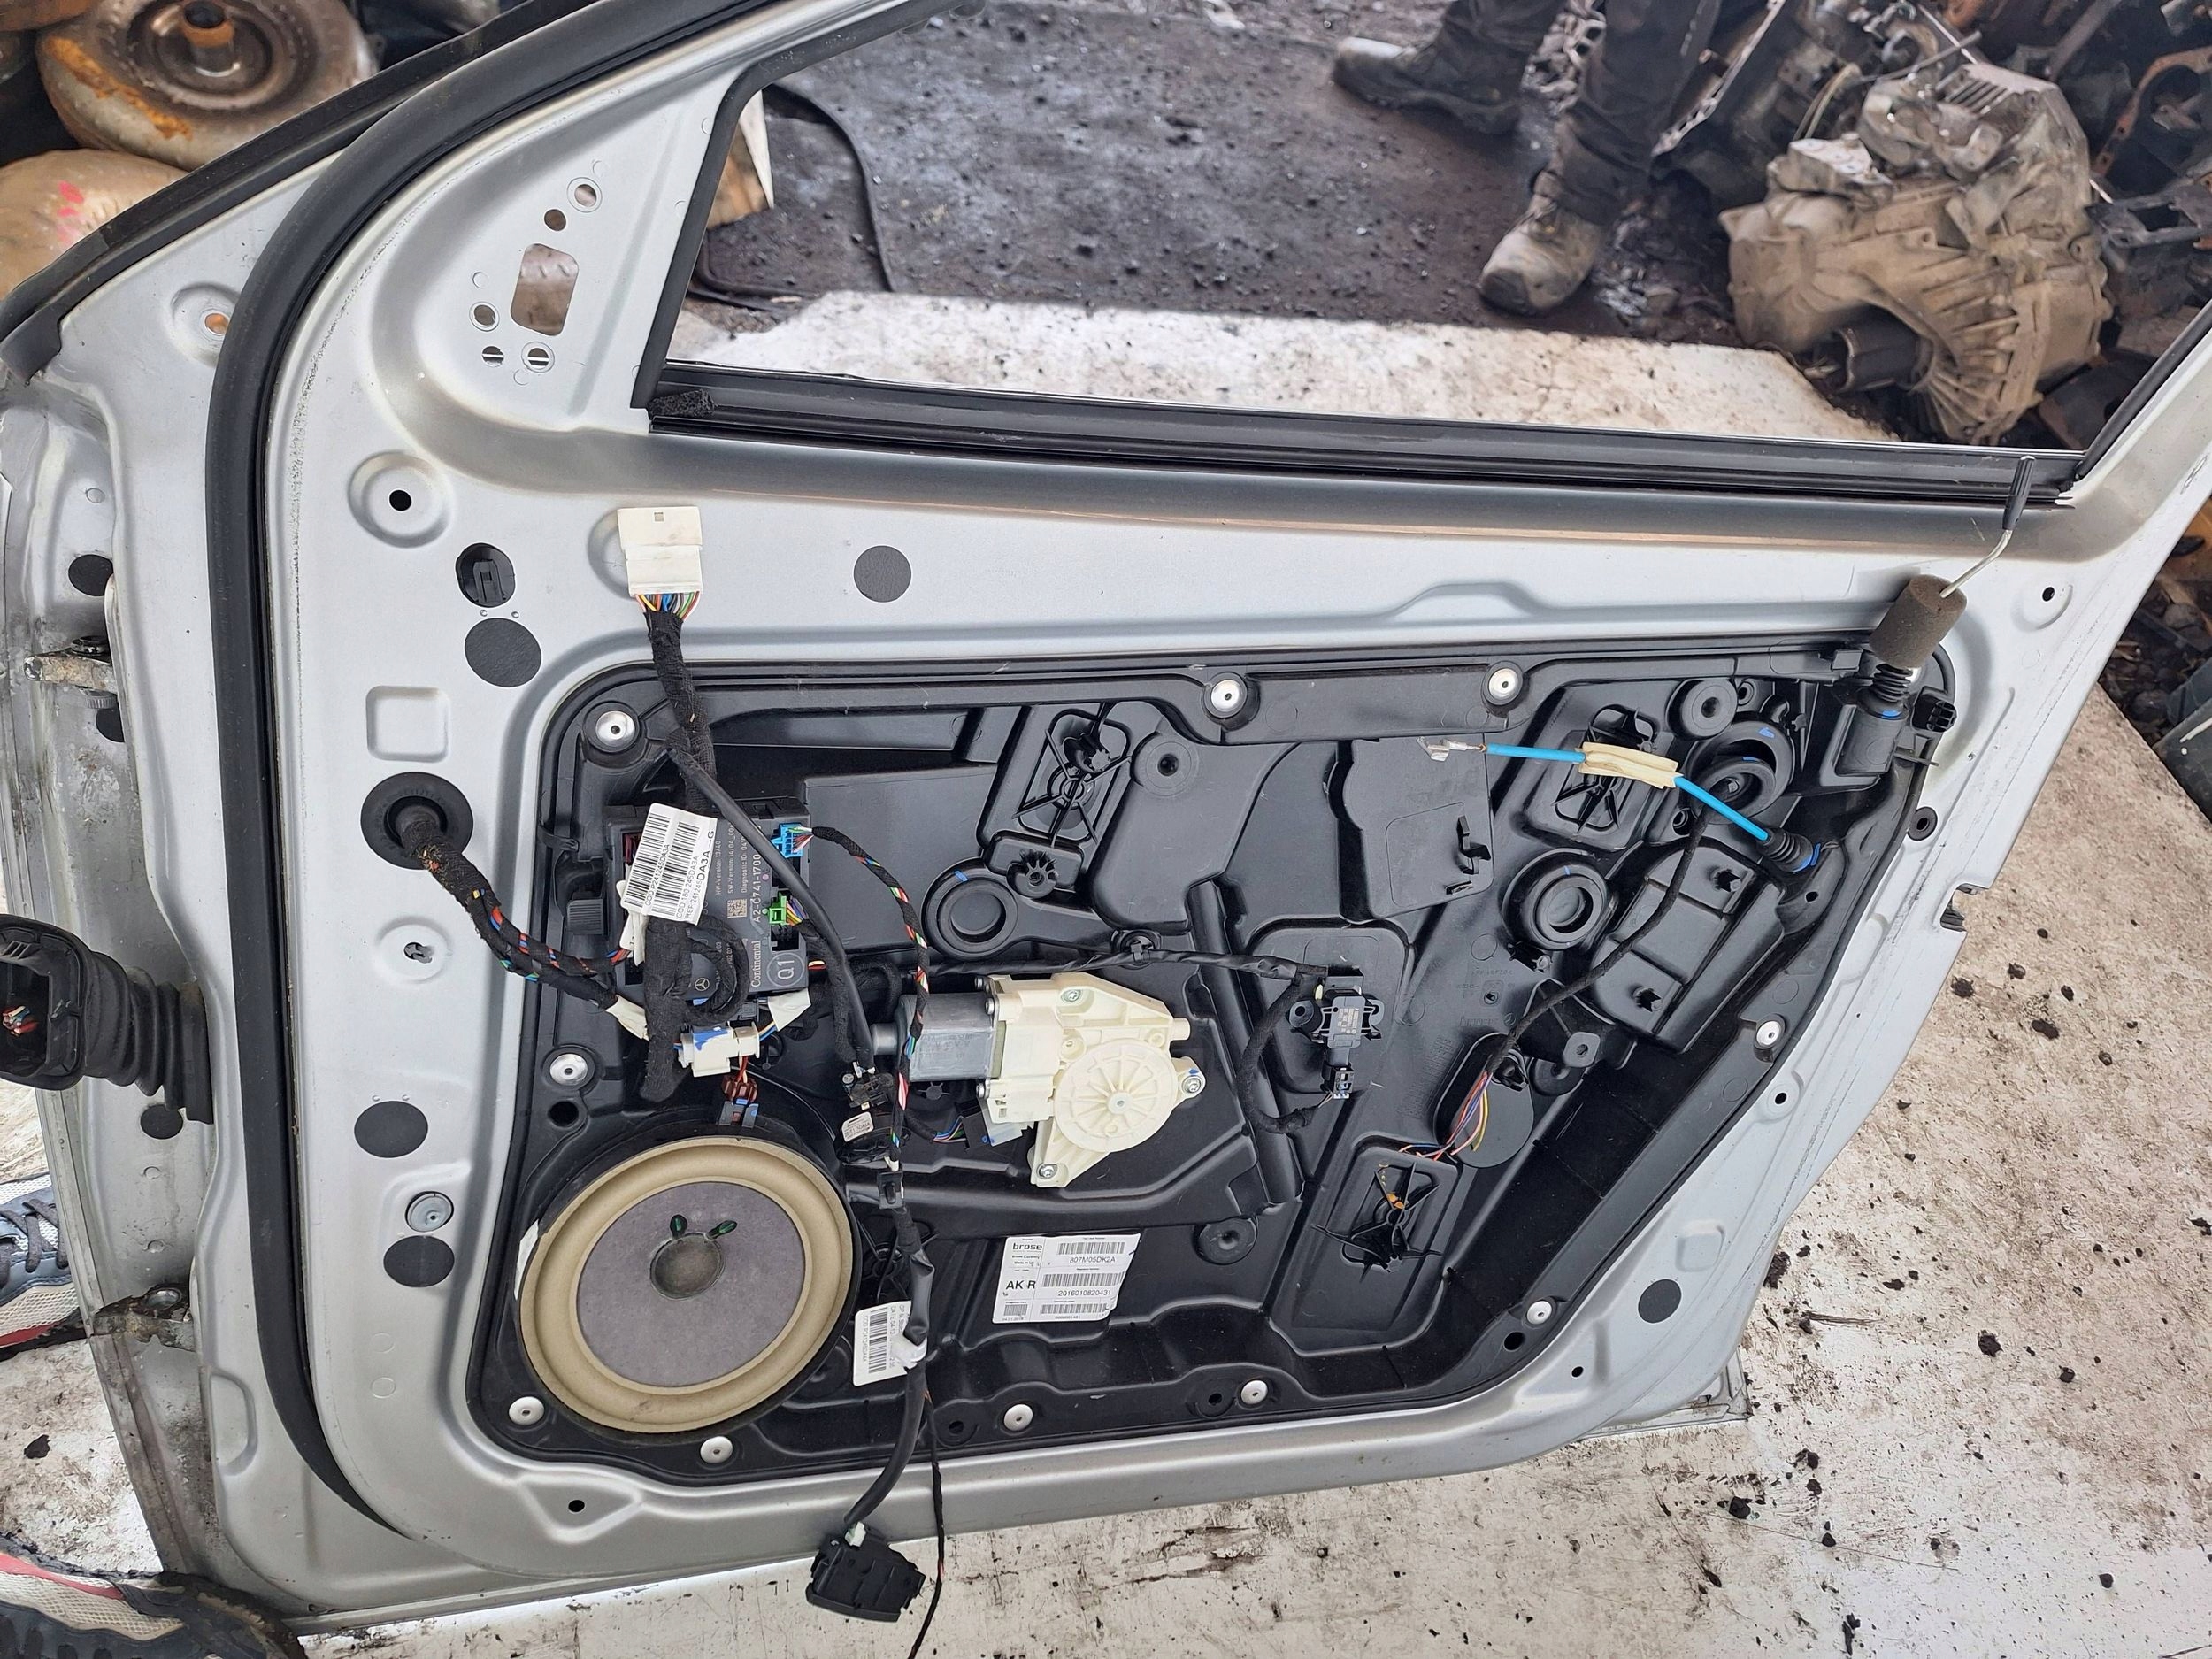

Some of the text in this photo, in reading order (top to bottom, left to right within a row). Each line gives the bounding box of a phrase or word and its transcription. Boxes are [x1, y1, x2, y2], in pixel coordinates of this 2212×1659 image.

[751, 940, 761, 987] Continental
[777, 959, 795, 980] Q1
[1005, 1279, 1036, 1290] AK R
